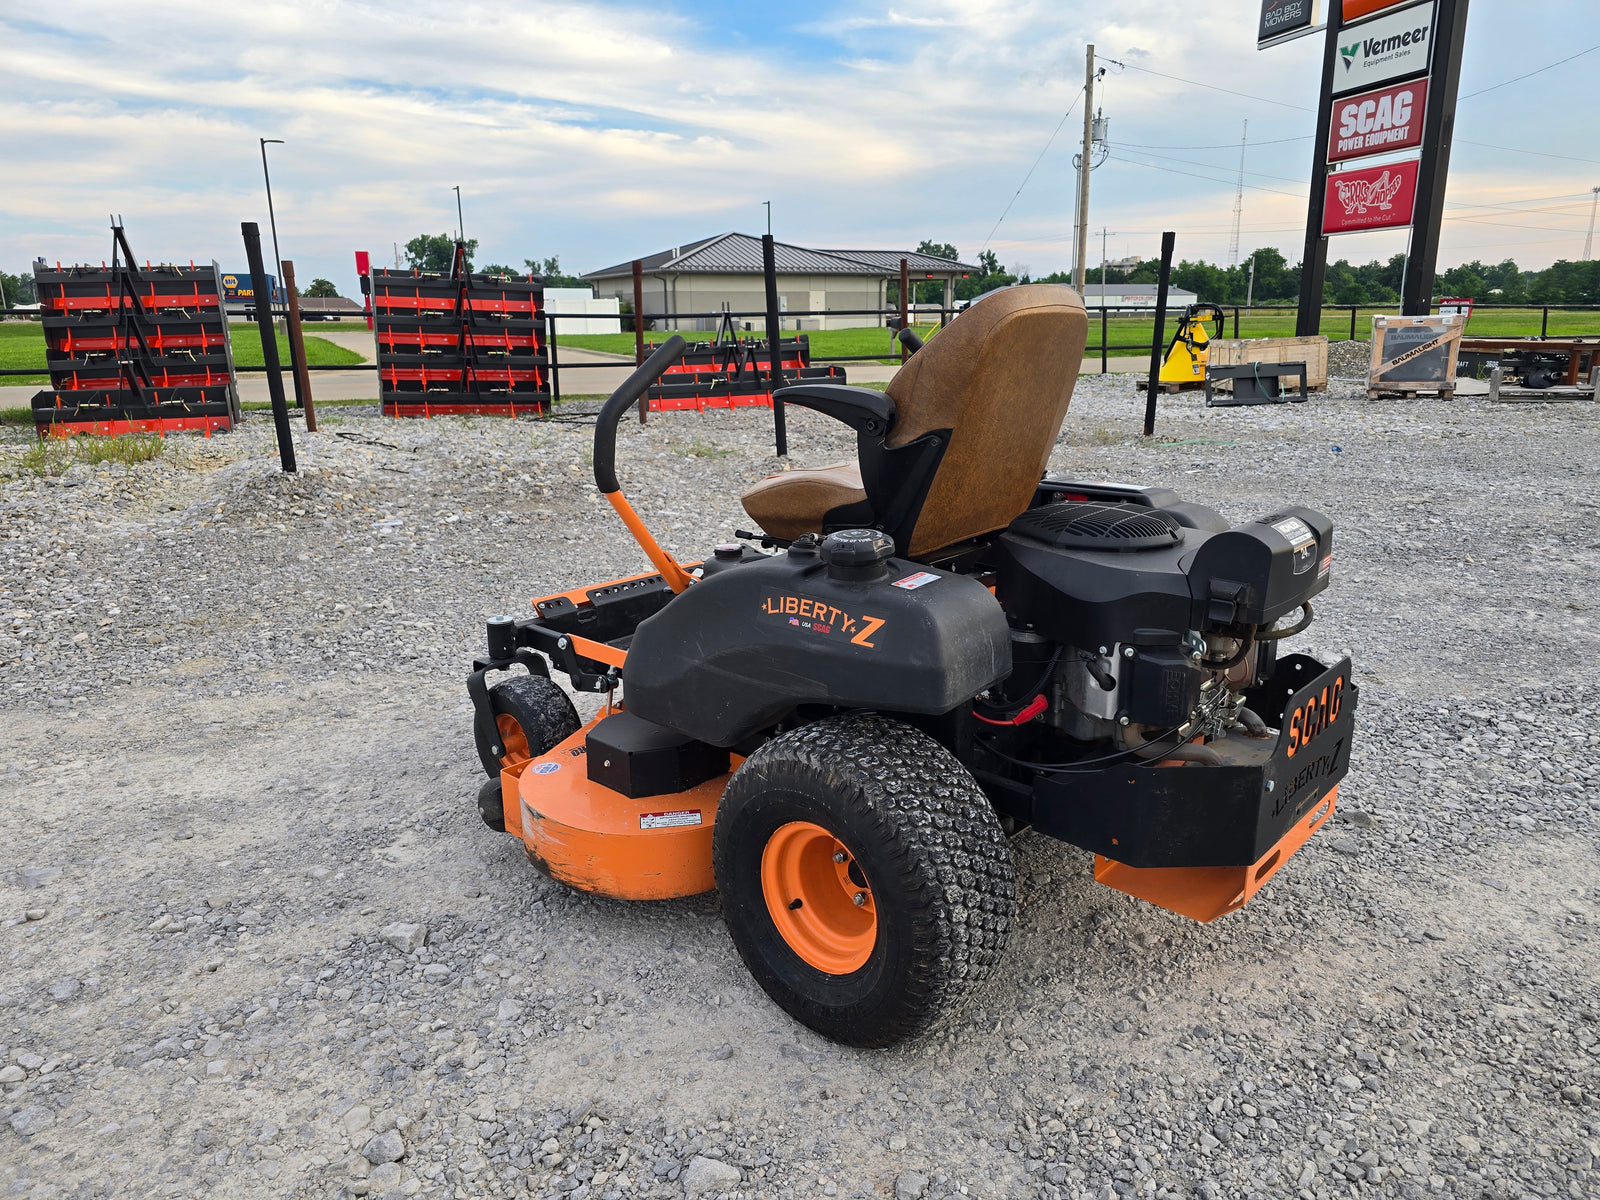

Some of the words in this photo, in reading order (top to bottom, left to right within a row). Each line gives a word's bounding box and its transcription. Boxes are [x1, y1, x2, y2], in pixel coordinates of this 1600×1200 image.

[1264, 9, 1302, 28] MOWERS
[1265, 8, 1282, 20] BAD
[1284, 1, 1302, 14] BOY
[1363, 25, 1428, 58] Vermeer
[1363, 54, 1394, 67] Equipment
[1394, 49, 1411, 59] Sales
[1339, 90, 1413, 138] SCAG
[1337, 136, 1364, 152] POWER
[1365, 126, 1410, 147] EQUIPMENT
[1341, 217, 1367, 225] Committed
[1391, 338, 1439, 366] BAUMALIGHT
[767, 596, 856, 632] LIBERTY
[850, 615, 886, 648] Z
[812, 622, 831, 634] SCAG
[1287, 675, 1343, 758] SCAG
[1275, 755, 1331, 818] LIBERTY
[1328, 737, 1344, 775] Z
